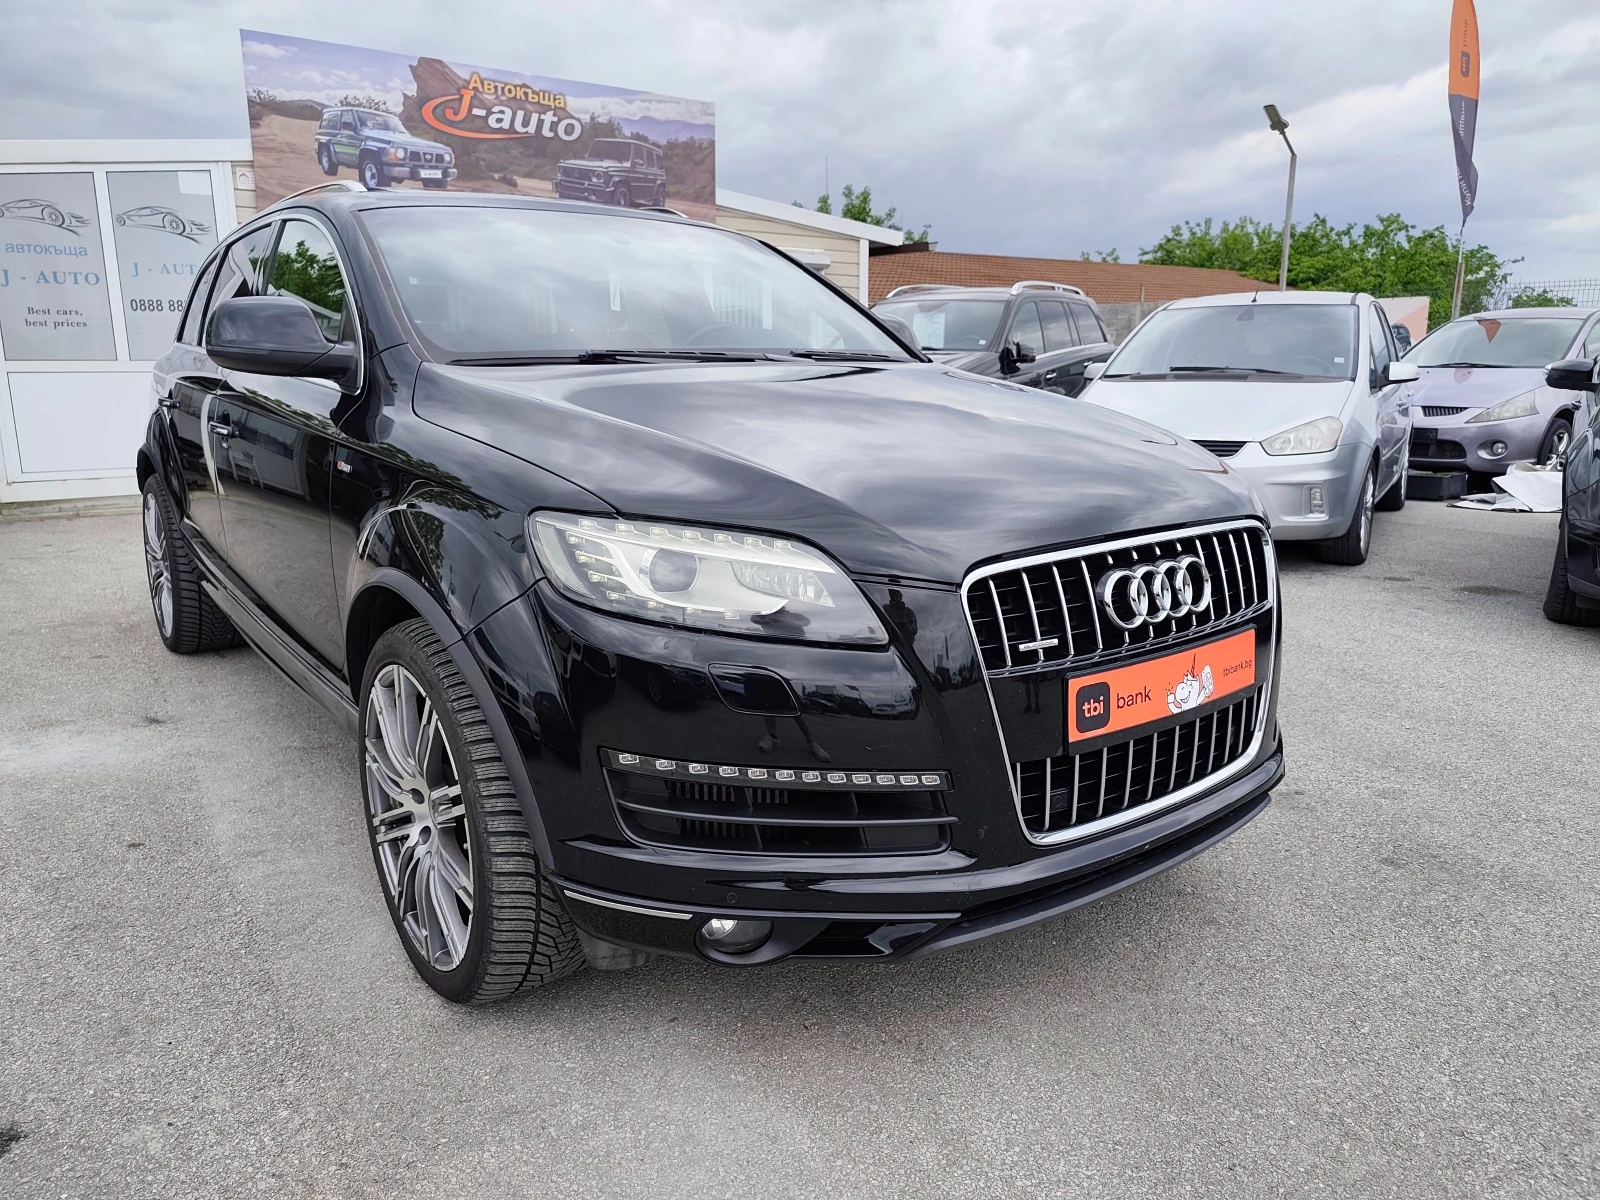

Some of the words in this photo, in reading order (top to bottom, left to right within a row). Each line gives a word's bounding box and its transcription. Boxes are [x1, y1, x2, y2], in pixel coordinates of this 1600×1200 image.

[467, 73, 567, 109] Автокъща
[444, 89, 583, 142] J-auto
[4, 242, 88, 258] автокъща
[0, 269, 10, 287] J
[35, 270, 101, 286] AUTO
[131, 262, 139, 278] J
[160, 263, 197, 276] AUT
[27, 306, 51, 315] Best
[56, 307, 84, 317] cars,
[130, 299, 164, 312] 0888
[168, 299, 186, 313] 88
[25, 318, 48, 328] best
[53, 319, 88, 329] prices
[1222, 659, 1253, 677] tbibank.bg
[1082, 695, 1105, 718] tbi
[1116, 685, 1152, 710] bank
